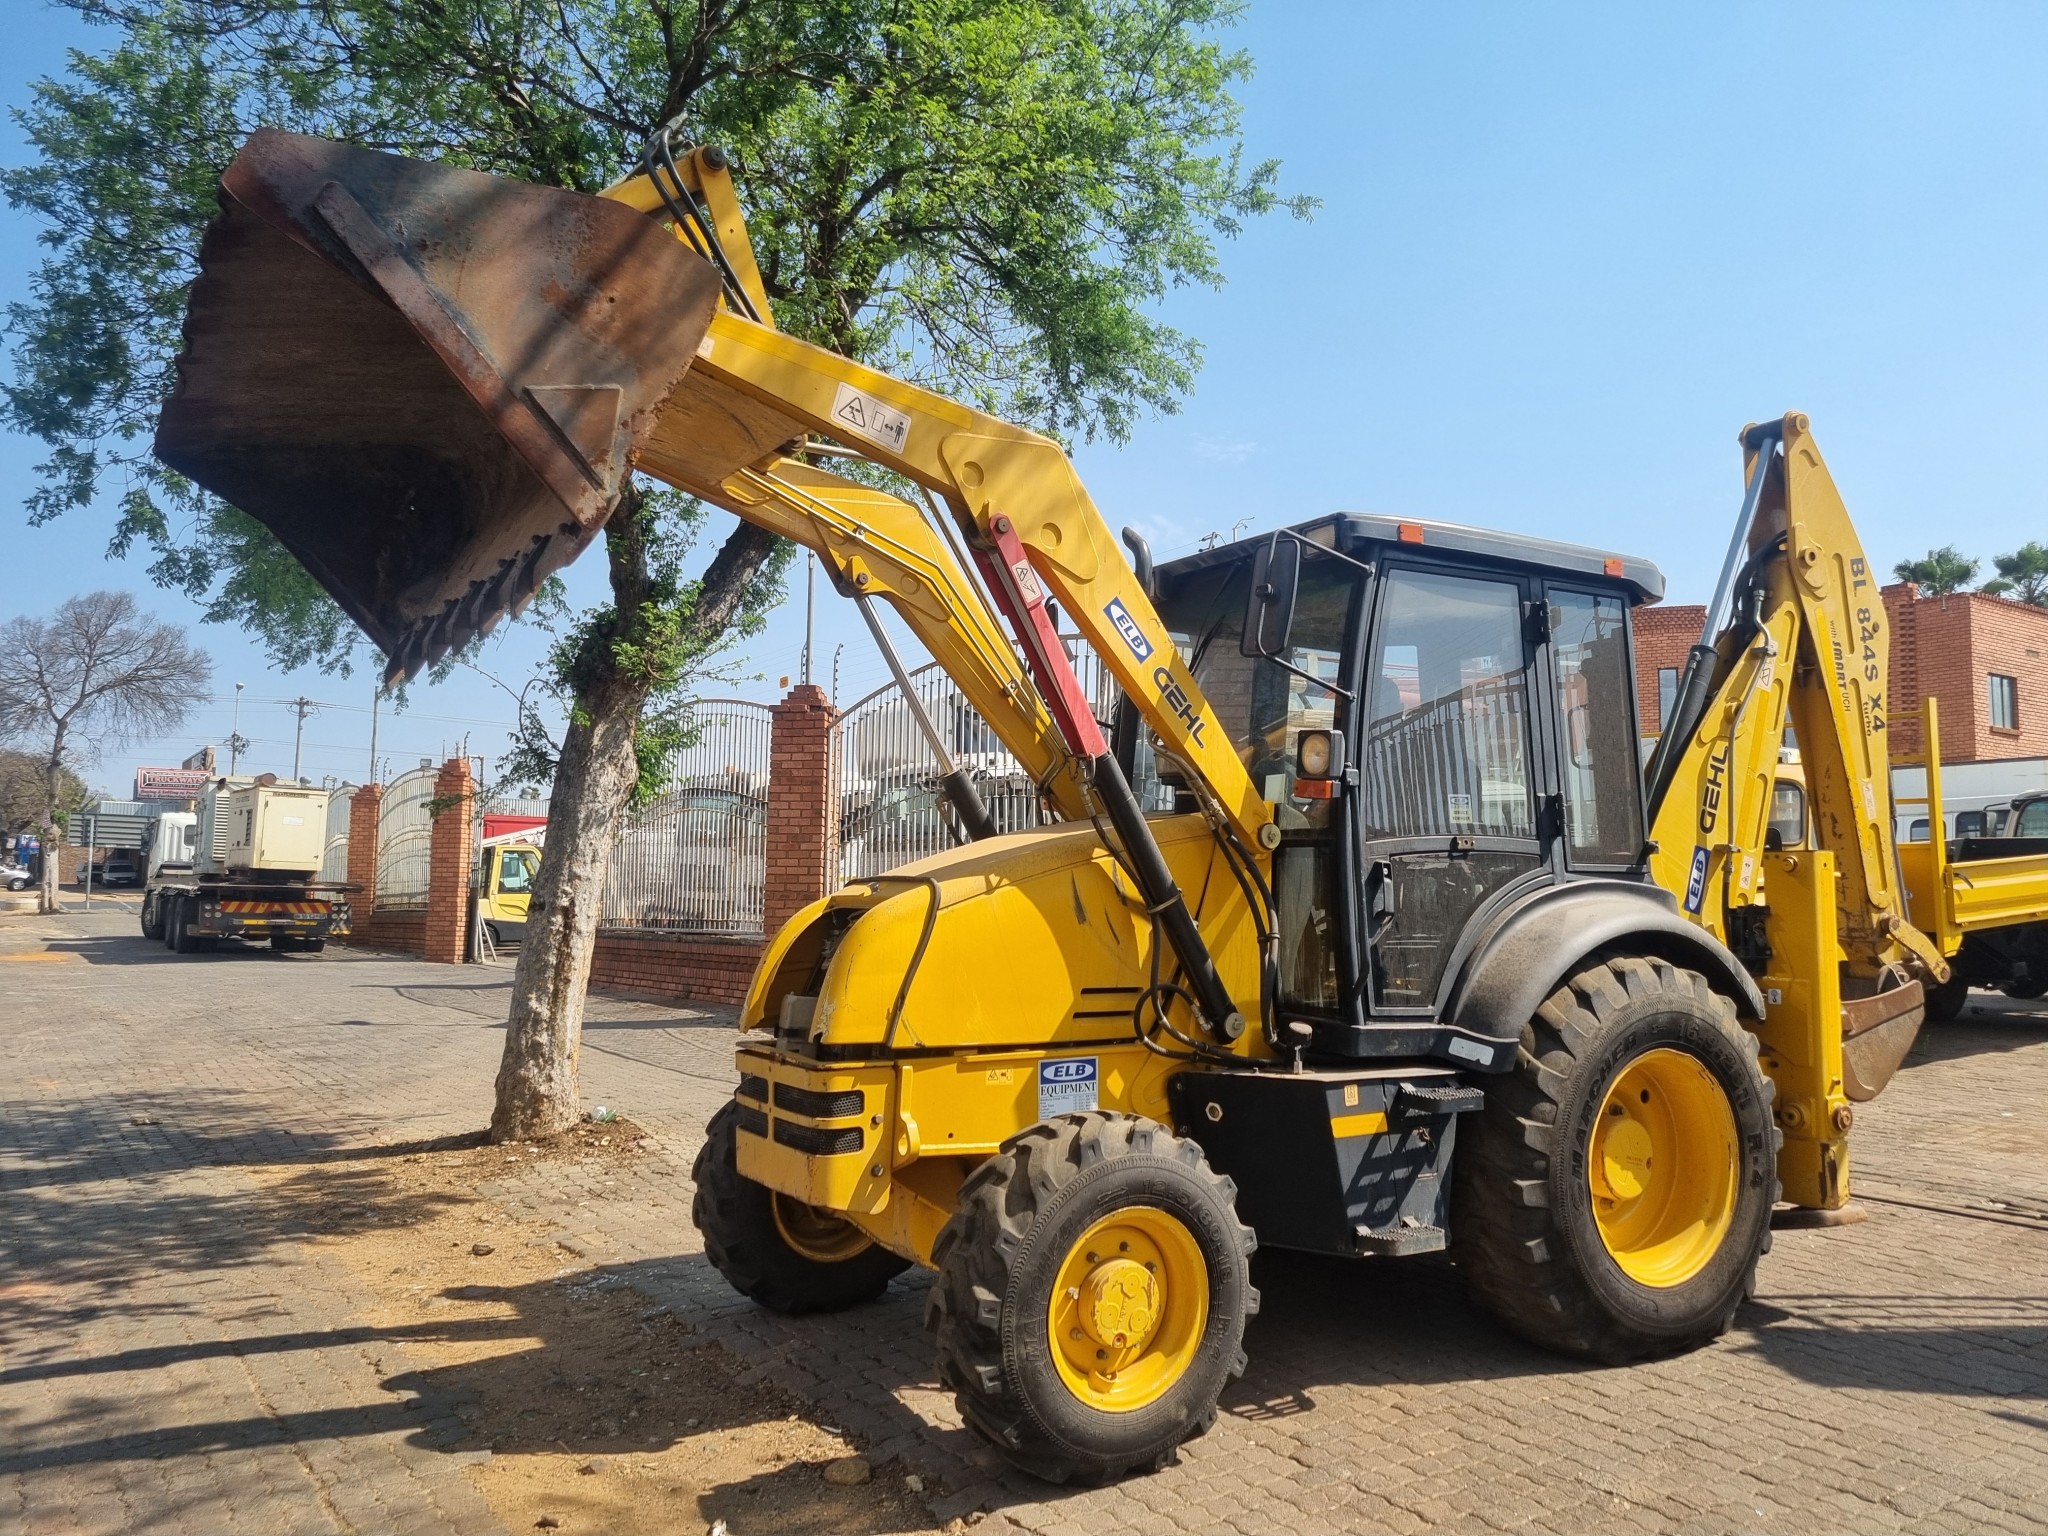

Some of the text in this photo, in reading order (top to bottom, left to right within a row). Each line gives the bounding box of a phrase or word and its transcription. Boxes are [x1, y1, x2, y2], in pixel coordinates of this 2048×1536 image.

[1115, 613, 1144, 649] ELB
[1829, 620, 1837, 641] with
[1850, 557, 1886, 732] BL 844S X4
[1153, 666, 1205, 749] GEHL
[1862, 701, 1872, 737] turbo
[149, 775, 204, 784] TRUCKWAYS
[1700, 745, 1728, 834] GEHL
[1690, 857, 1705, 897] ELB
[1040, 1081, 1097, 1097] EQUIPMENT
[1053, 1064, 1087, 1078] ELB
